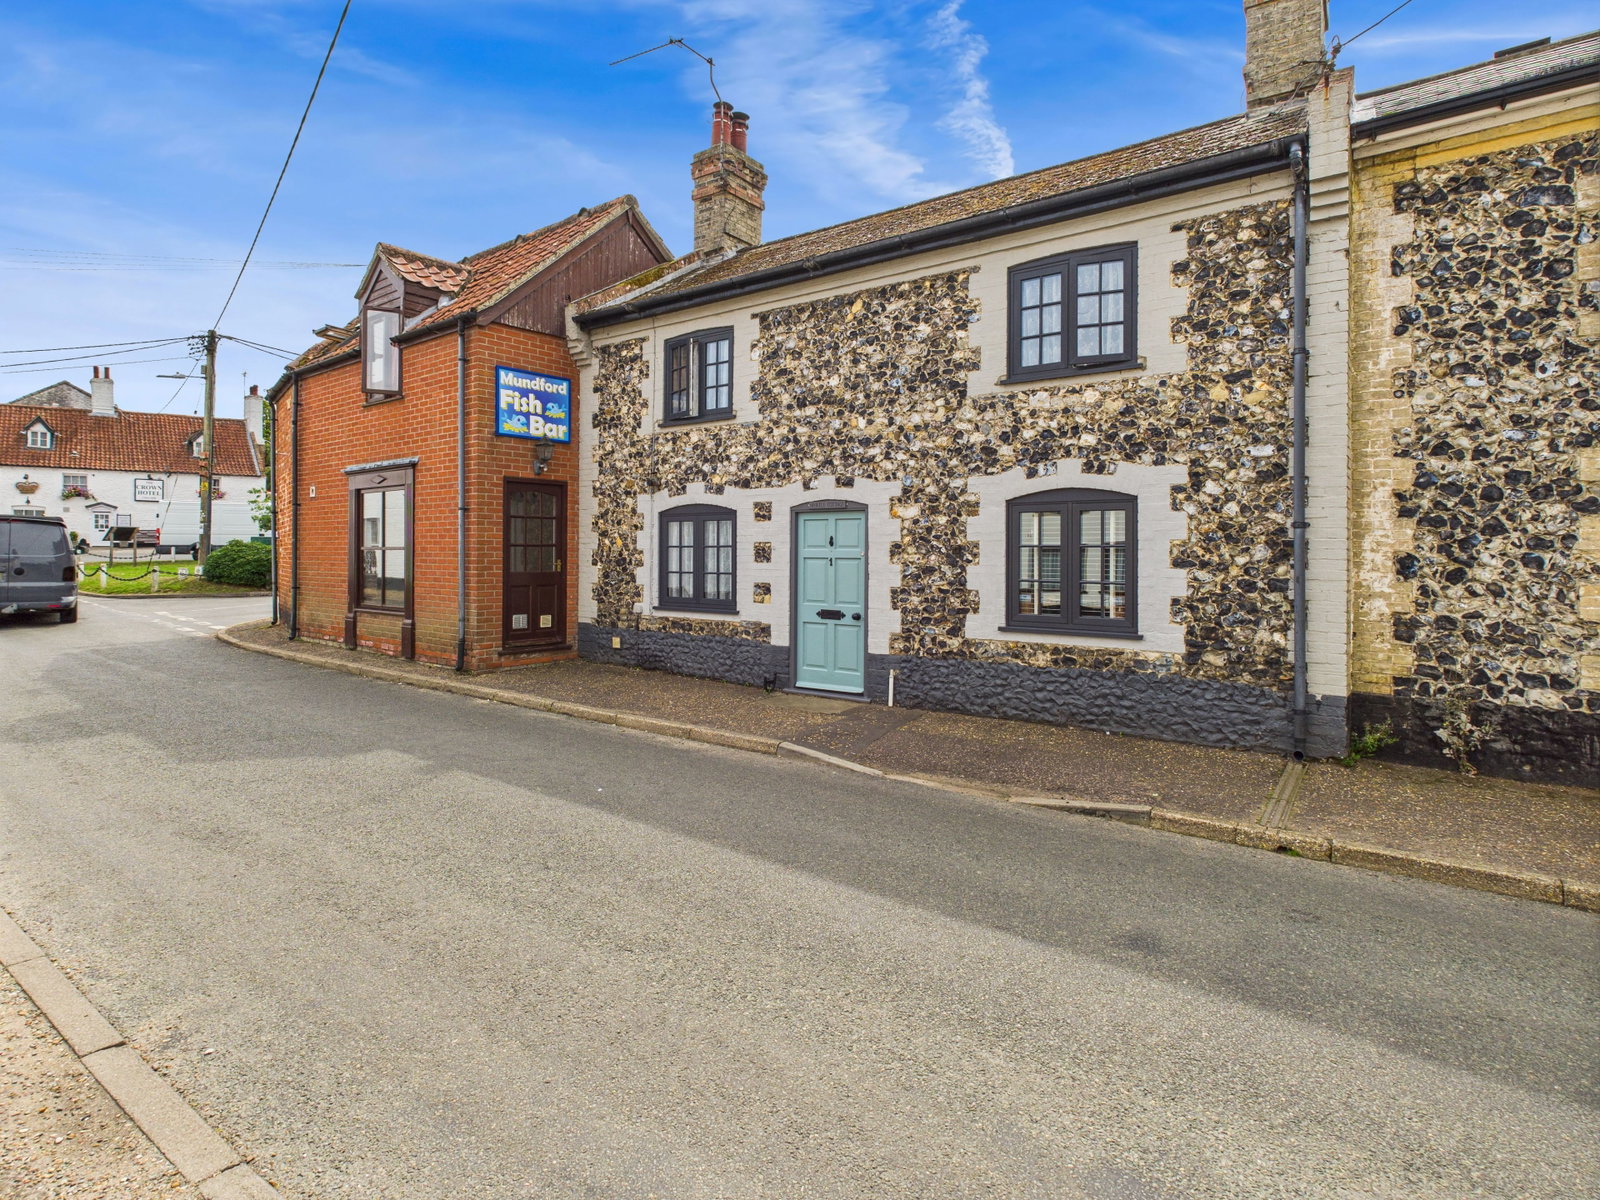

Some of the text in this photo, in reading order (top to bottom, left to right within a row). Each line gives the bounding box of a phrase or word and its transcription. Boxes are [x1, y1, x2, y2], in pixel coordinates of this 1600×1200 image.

[500, 371, 567, 395] Mundford
[500, 389, 543, 415] Fish
[529, 415, 568, 439] Bar
